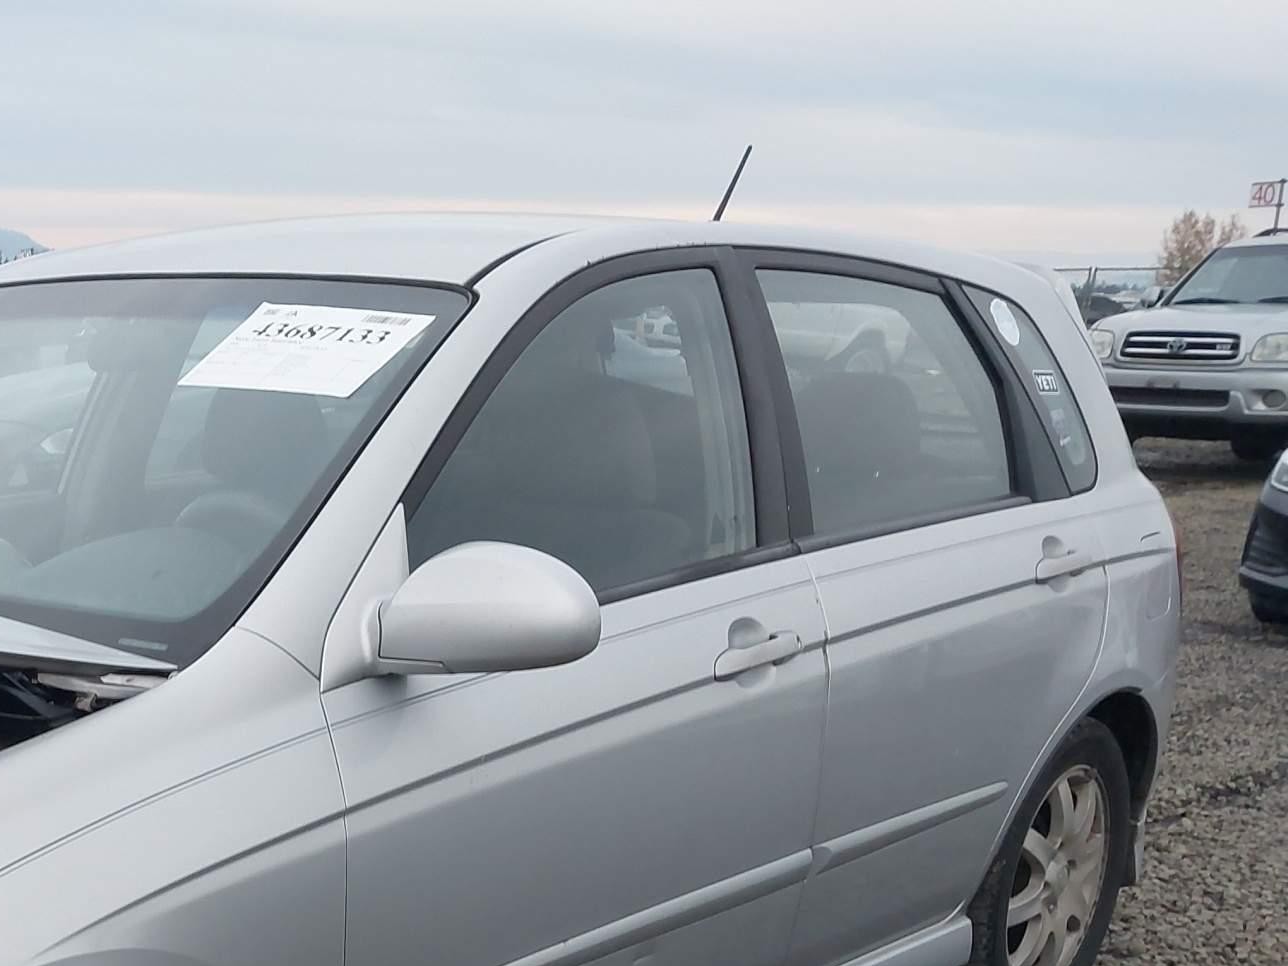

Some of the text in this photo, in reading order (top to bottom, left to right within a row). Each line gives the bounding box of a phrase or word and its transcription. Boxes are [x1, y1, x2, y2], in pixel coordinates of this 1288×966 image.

[1252, 184, 1275, 204] 40
[252, 322, 391, 345] 43687133
[1035, 376, 1057, 391] YETI
